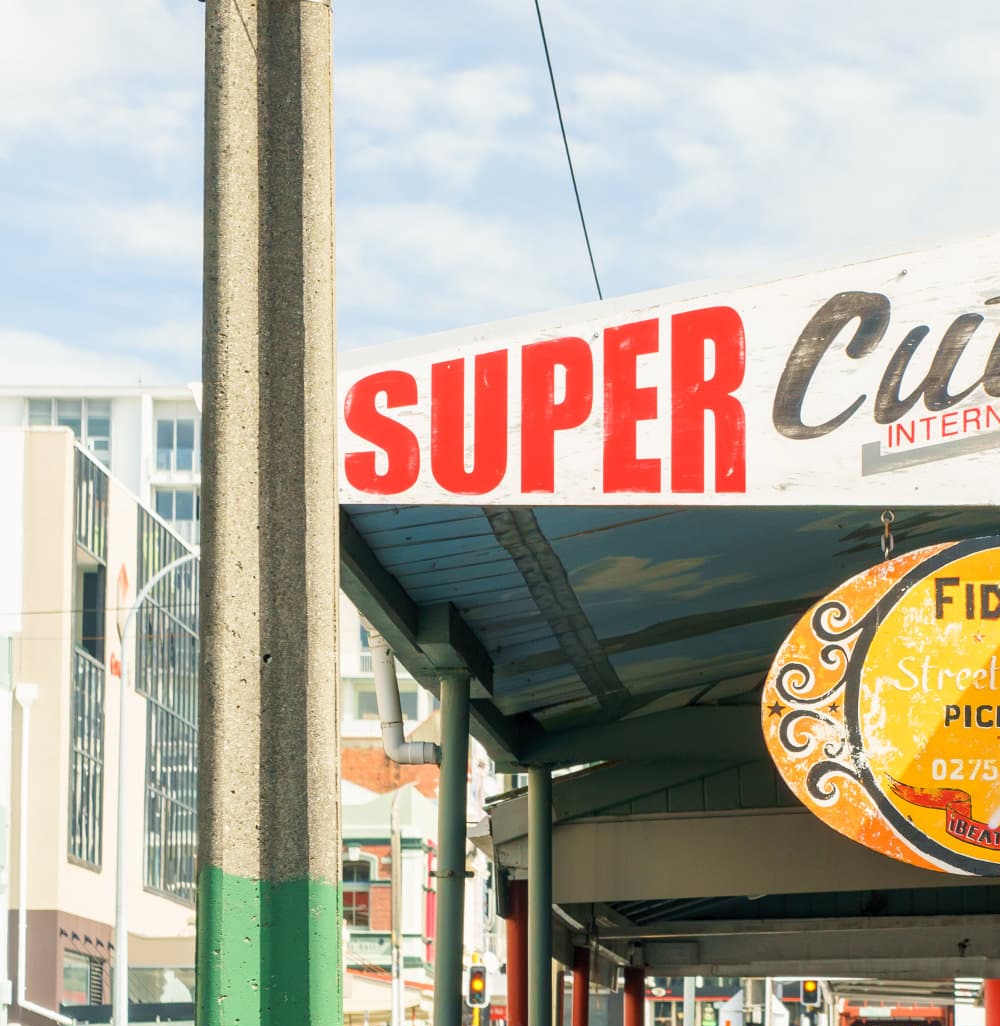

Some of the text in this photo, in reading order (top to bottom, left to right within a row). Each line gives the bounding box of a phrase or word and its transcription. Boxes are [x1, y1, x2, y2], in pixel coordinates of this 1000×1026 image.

[345, 305, 747, 495] SUPER
[897, 655, 1000, 693] Street
[931, 758, 999, 782] 0275
